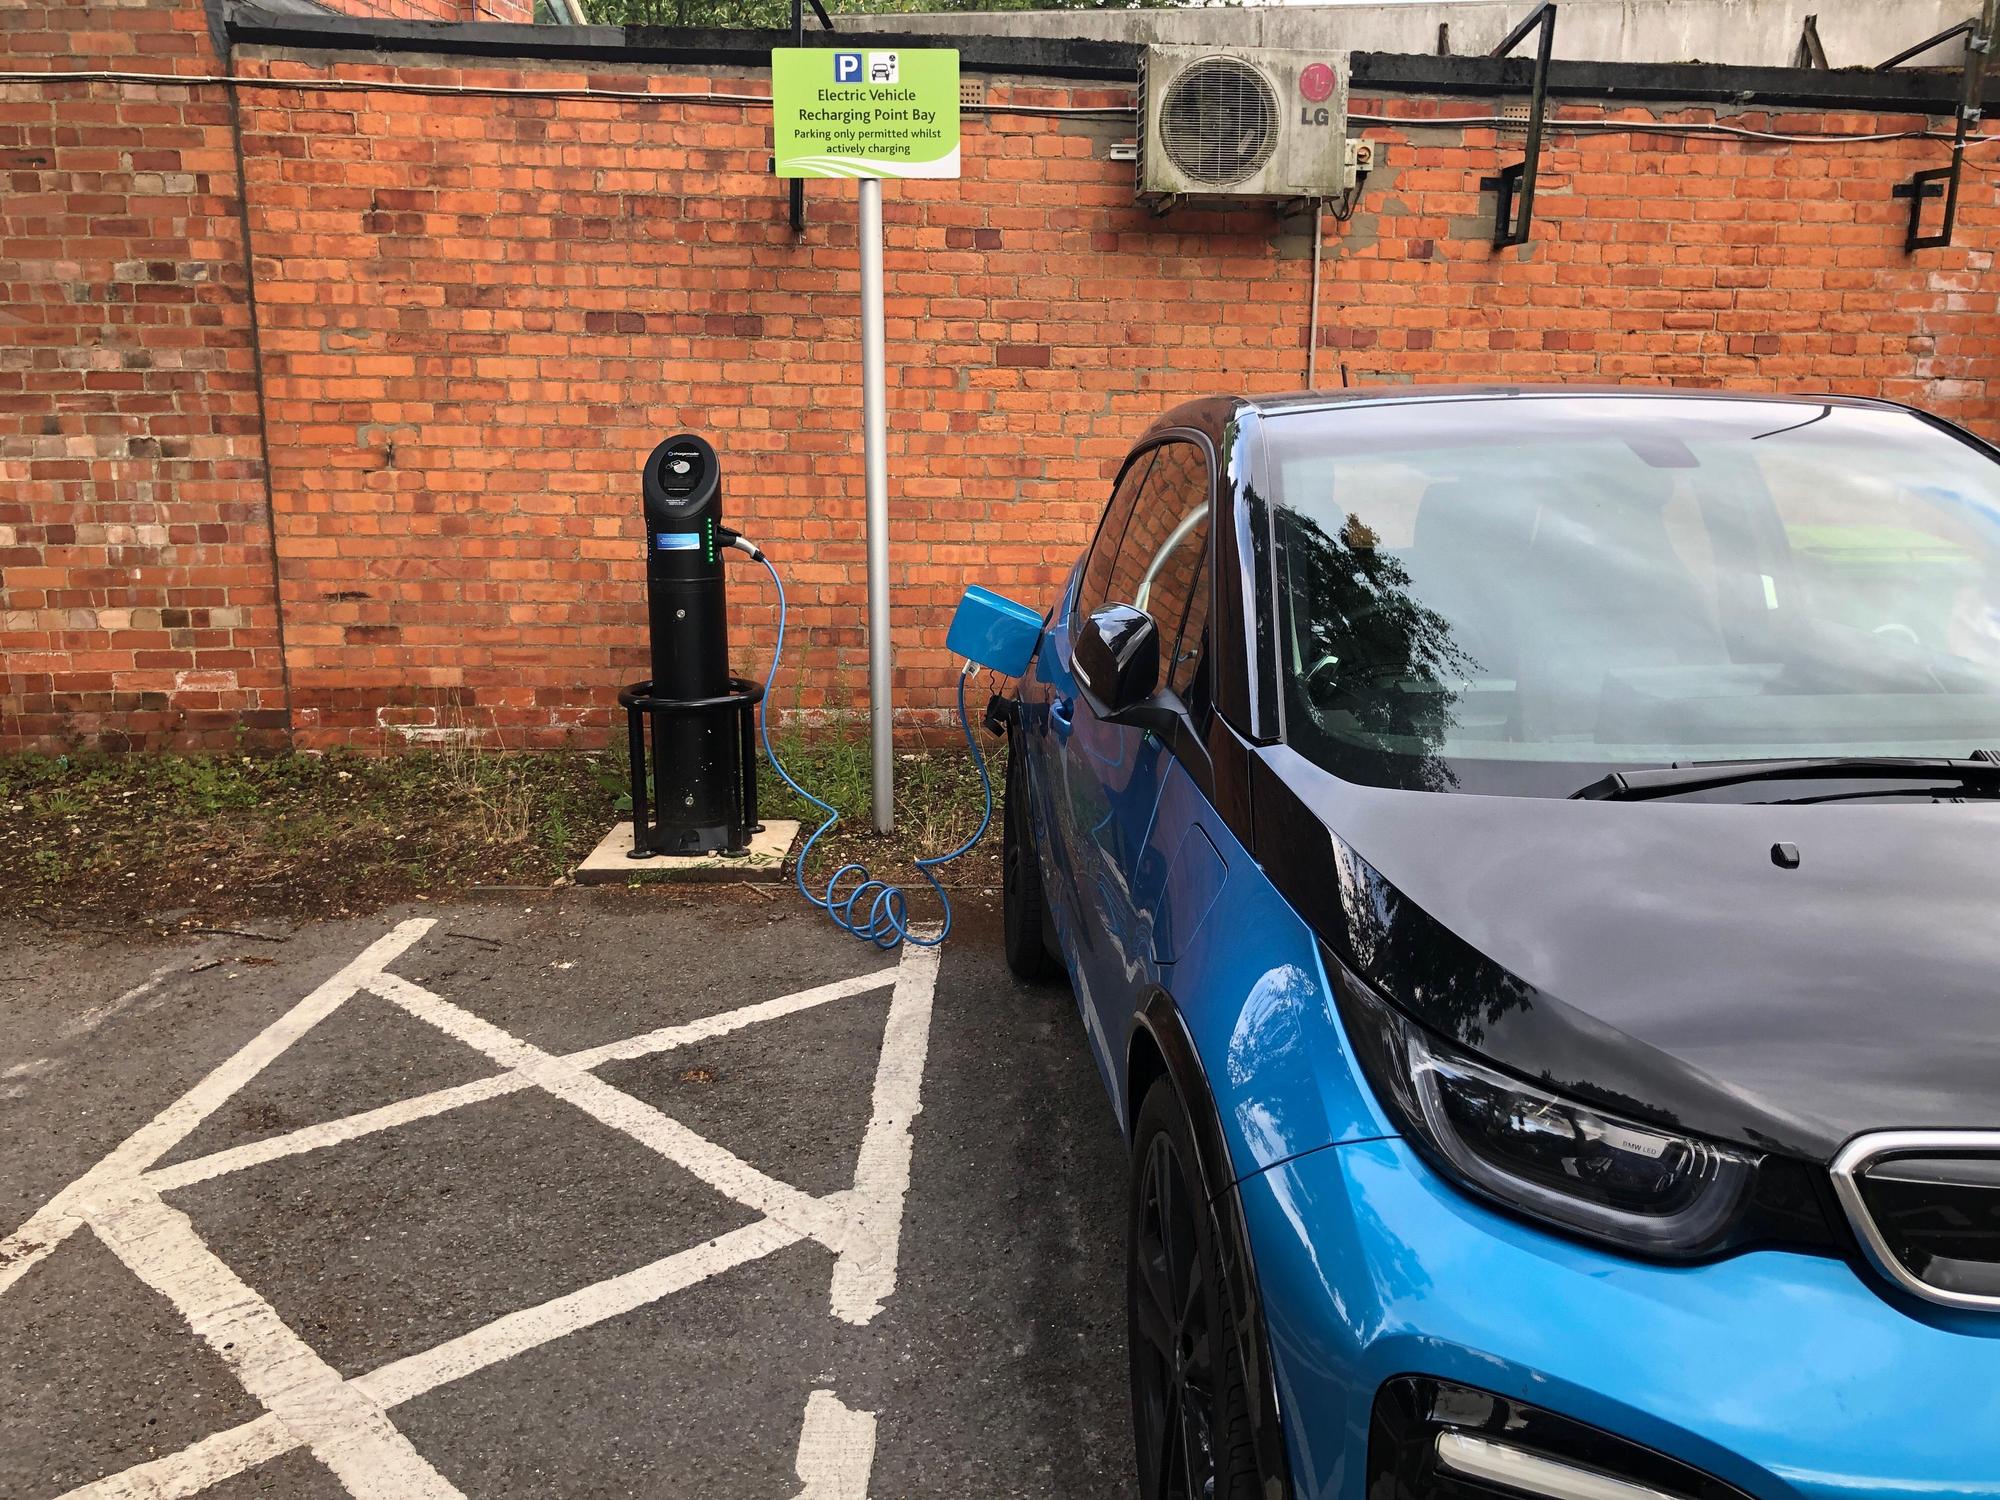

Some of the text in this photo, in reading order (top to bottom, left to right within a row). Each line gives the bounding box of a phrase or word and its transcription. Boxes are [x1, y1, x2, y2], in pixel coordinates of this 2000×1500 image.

[839, 55, 858, 81] P
[818, 89, 916, 101] Electric Vehicle
[799, 109, 936, 124] Recharging Point Bay
[1301, 107, 1329, 126] LG
[794, 129, 941, 141] Parking only permitted whilst
[826, 143, 911, 156] actively charging
[1622, 1140, 1657, 1155] BMW LED
